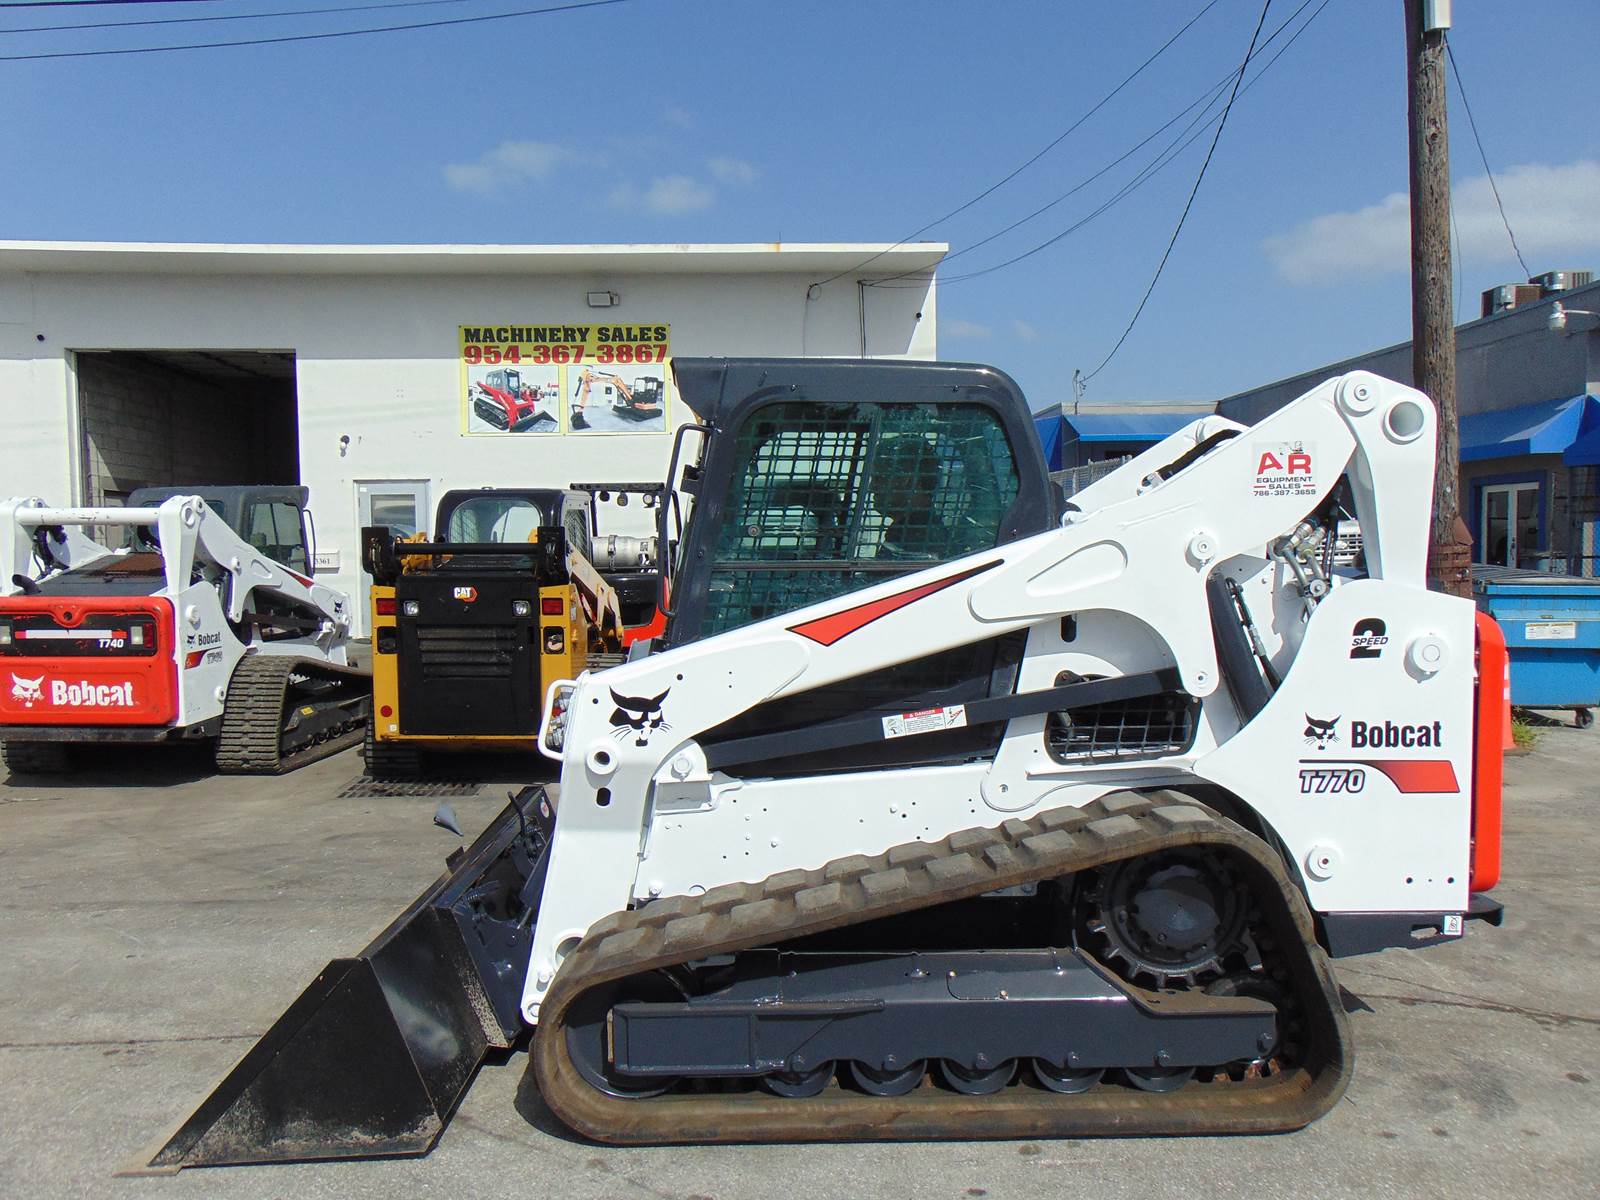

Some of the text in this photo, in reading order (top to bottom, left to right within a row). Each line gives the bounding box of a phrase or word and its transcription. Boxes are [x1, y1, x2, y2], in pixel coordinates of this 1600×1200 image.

[464, 326, 667, 343] MACHINERY SALES
[464, 344, 668, 365] 954-367-3867
[1256, 476, 1313, 484] EQUIPMENT
[454, 587, 472, 599] CAT
[98, 639, 124, 648] T740
[198, 631, 221, 646] Bobcat
[1350, 618, 1387, 659] 2
[1352, 637, 1389, 647] SPEED
[51, 680, 134, 706] Bobcat
[1351, 720, 1442, 748] Bobcat
[1299, 769, 1366, 793] T770
